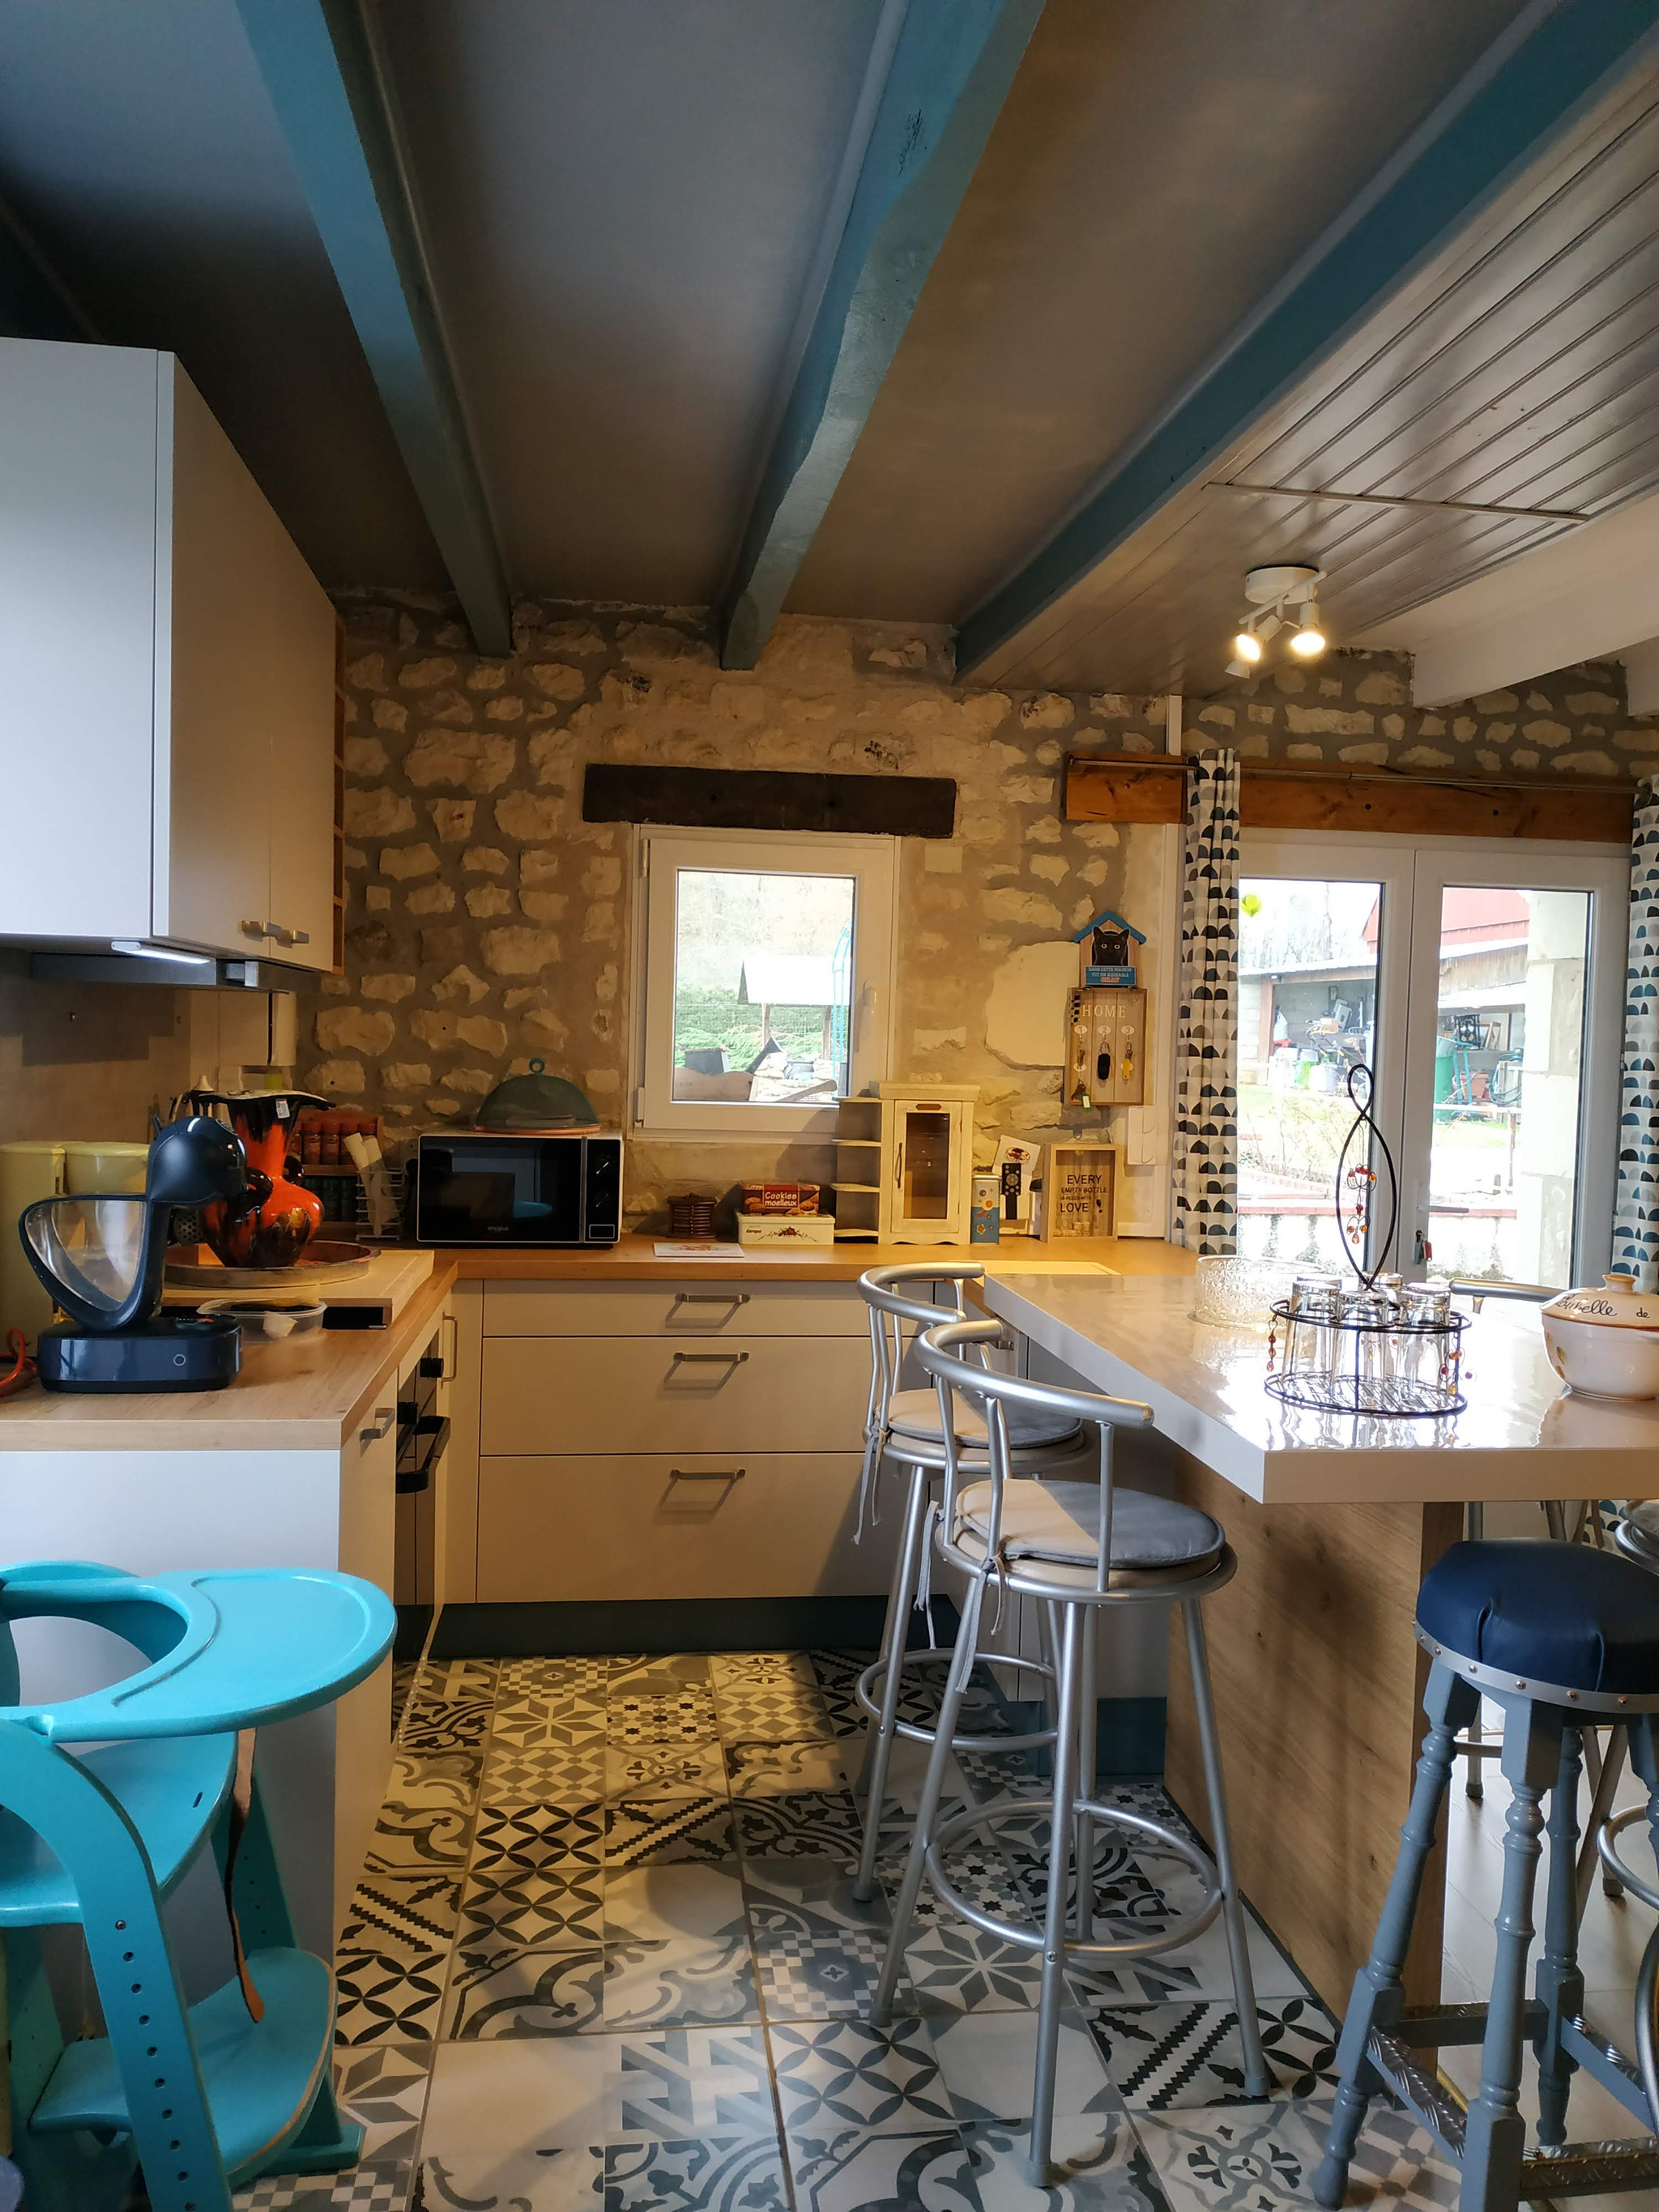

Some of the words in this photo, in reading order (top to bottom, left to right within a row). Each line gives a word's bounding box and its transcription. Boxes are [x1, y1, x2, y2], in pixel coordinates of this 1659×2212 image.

[1082, 1004, 1126, 1017] HOME
[1067, 1174, 1102, 1184] EVERY
[765, 1191, 797, 1200] Cookies
[1060, 1202, 1089, 1213] LOVE
[1636, 1307, 1650, 1319] de
